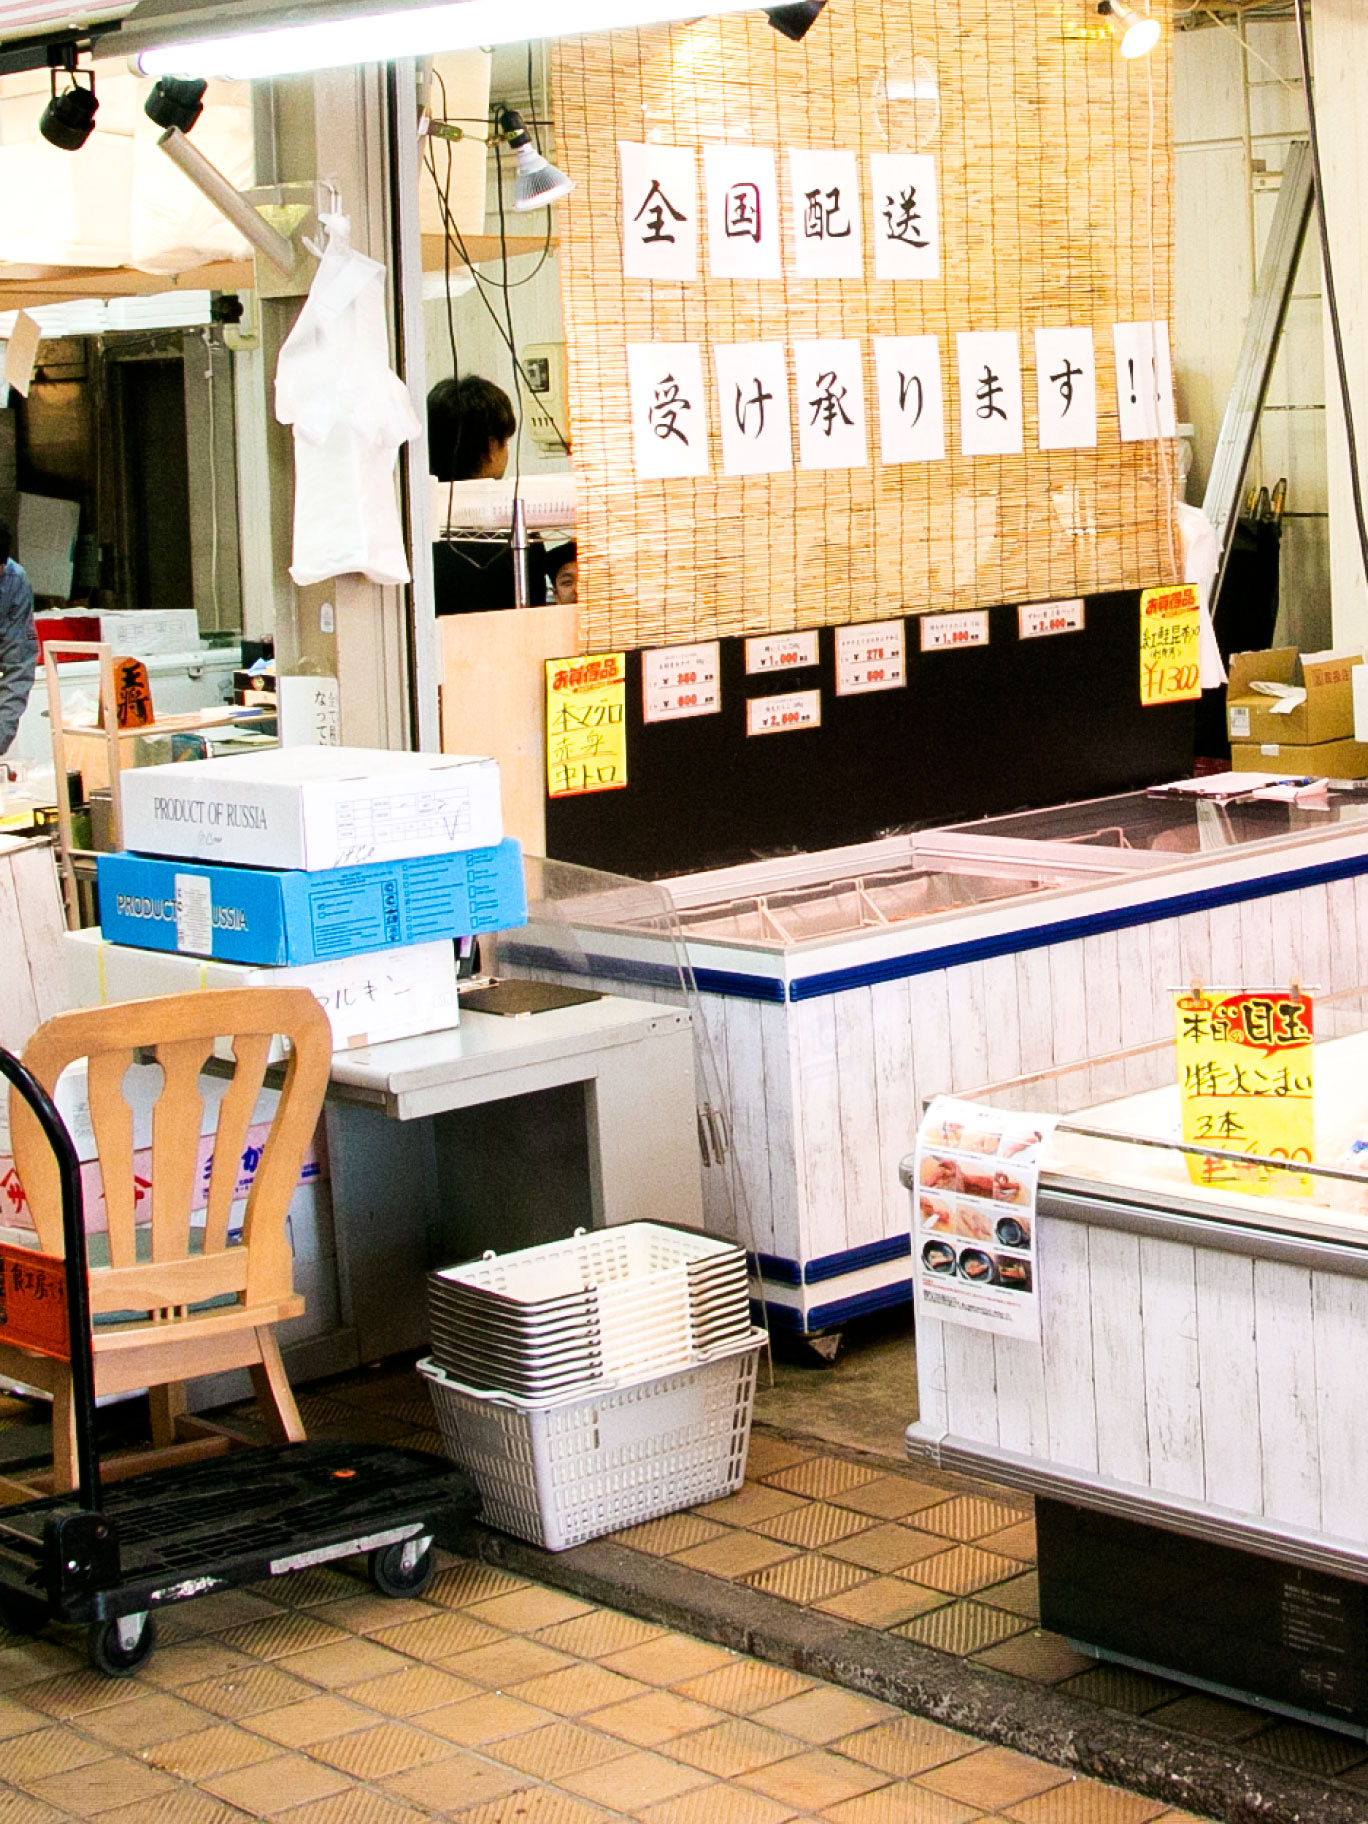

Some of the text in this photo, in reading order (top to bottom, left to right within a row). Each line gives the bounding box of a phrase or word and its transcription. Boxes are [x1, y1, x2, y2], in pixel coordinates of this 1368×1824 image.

[633, 178, 930, 249] 全国配送
[553, 658, 618, 691] お買得品
[117, 661, 149, 726] 王将
[551, 698, 622, 732] 本マグロ
[553, 730, 604, 761] 赤身
[556, 764, 616, 790] 中トロ
[154, 797, 268, 830] PRODUCT OF RUSSIA
[116, 893, 178, 922] PRODUCT
[211, 906, 249, 931] USSIA
[1184, 1000, 1311, 1043] 本日の目玉
[1185, 1061, 1312, 1096] 特大こまい
[1196, 1110, 1244, 1137] 3本
